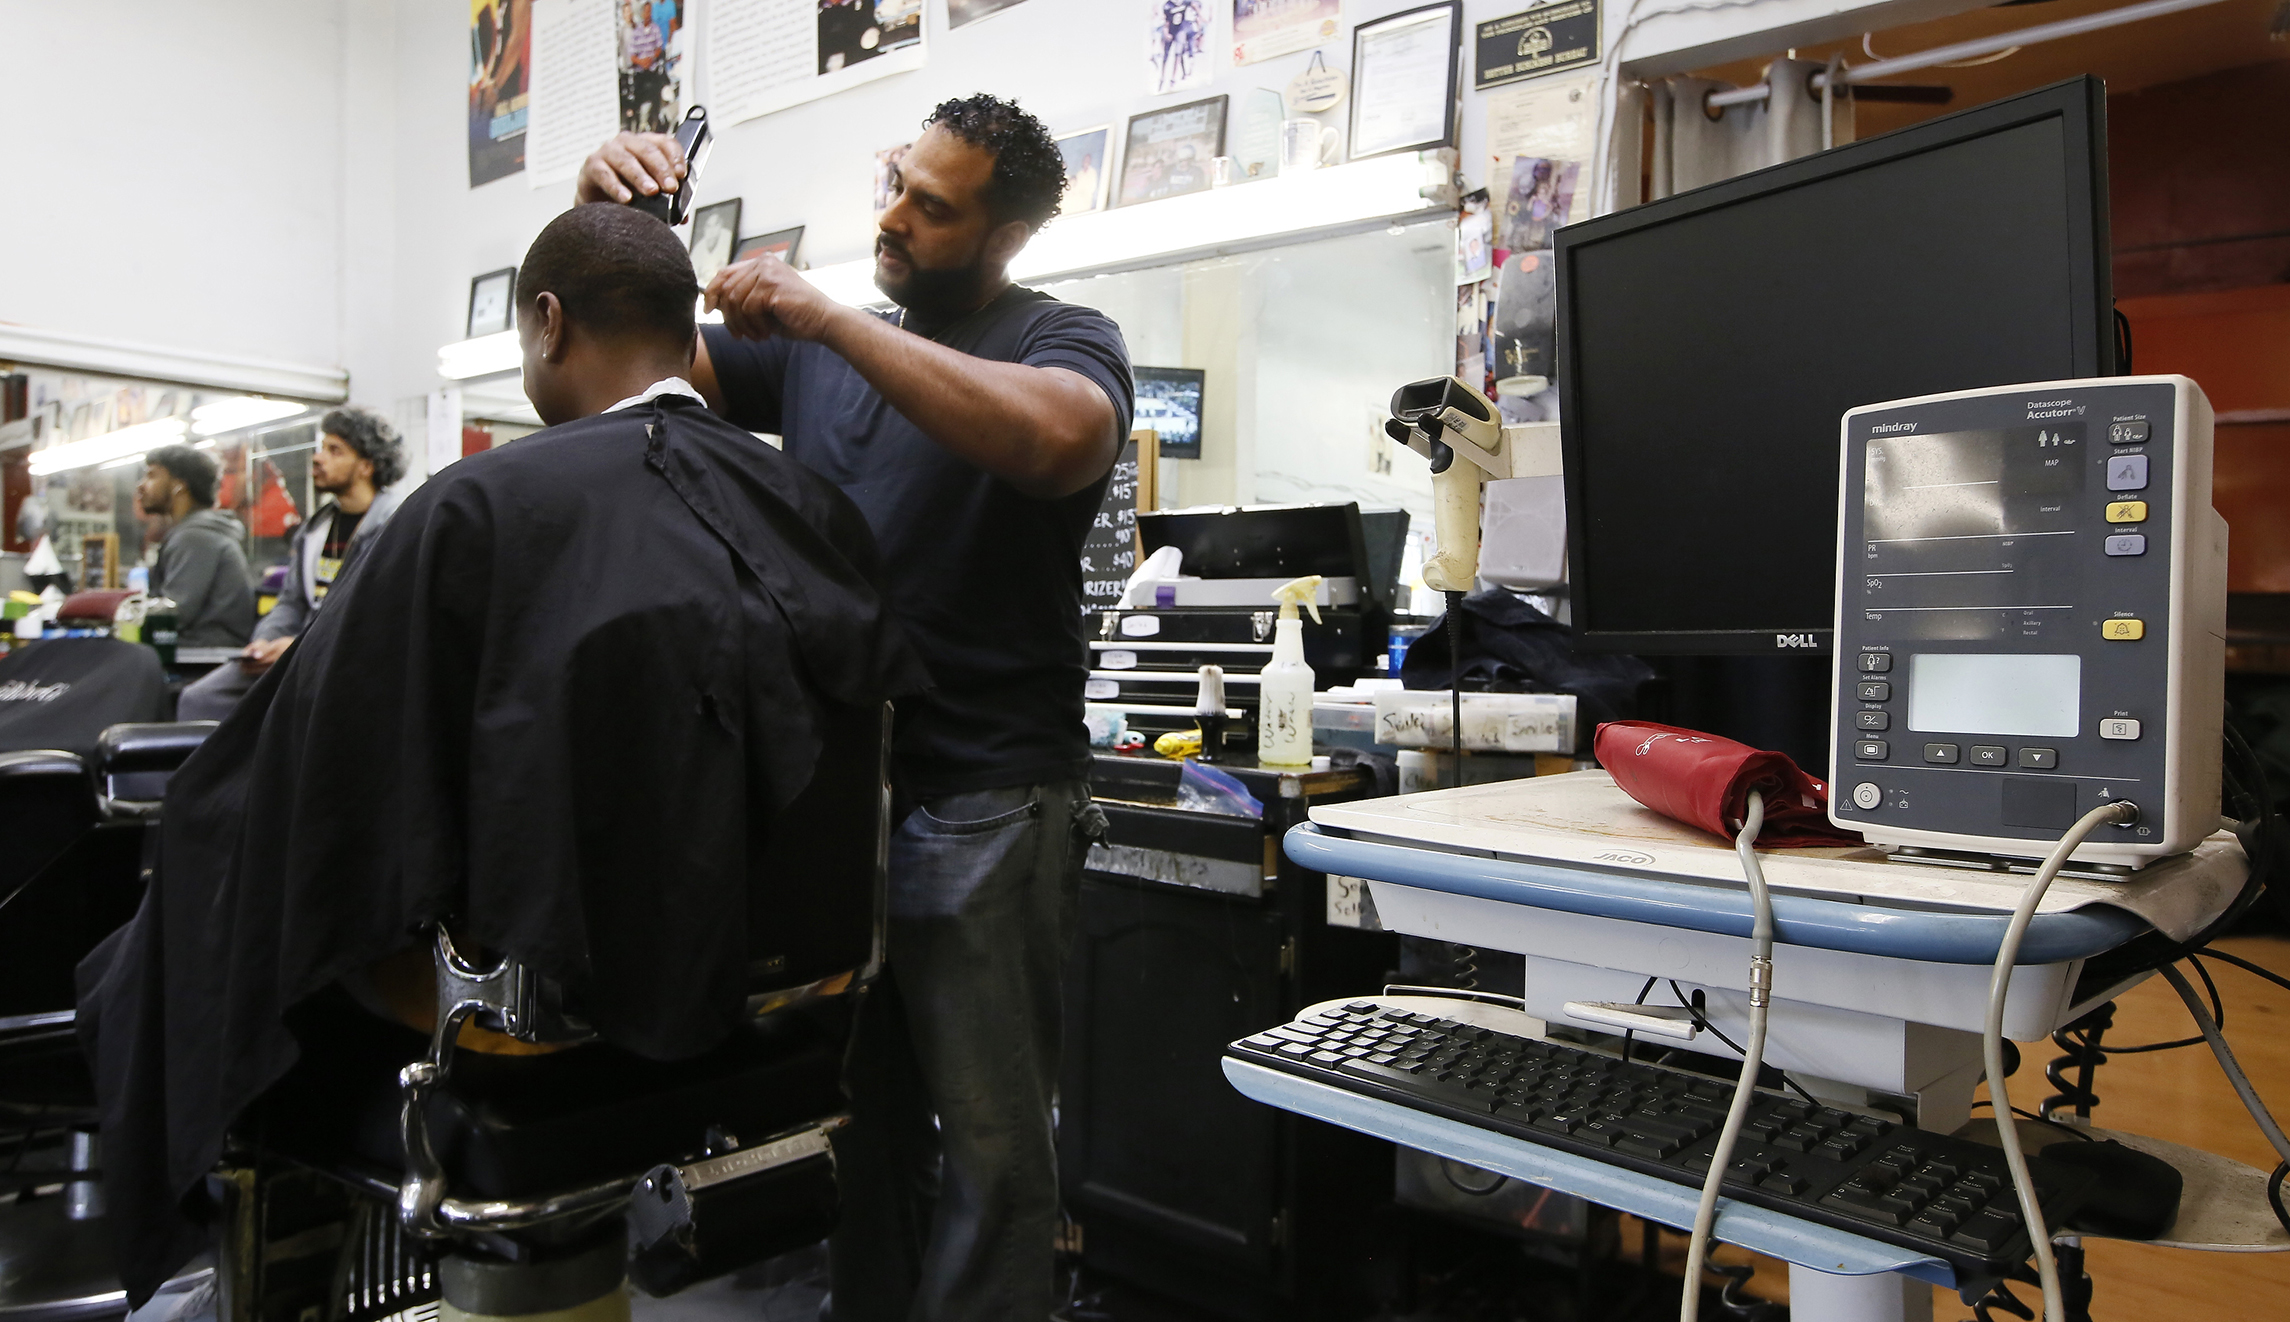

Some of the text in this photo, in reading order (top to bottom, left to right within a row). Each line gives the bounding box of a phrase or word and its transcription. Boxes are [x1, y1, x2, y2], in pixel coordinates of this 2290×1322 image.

[2027, 399, 2072, 410] Datascope
[2026, 409, 2073, 420] Accutorr
[2112, 414, 2135, 422] Patient
[1871, 422, 1918, 434] mindray
[2044, 458, 2060, 467] MAP
[2040, 505, 2061, 513] Interval
[2114, 526, 2138, 534] Interval
[1867, 544, 1877, 552] PR
[1866, 612, 1882, 621] Temp
[1776, 633, 1818, 648] DELL
[1981, 751, 1994, 759] OK
[1593, 852, 1648, 864] JACO
